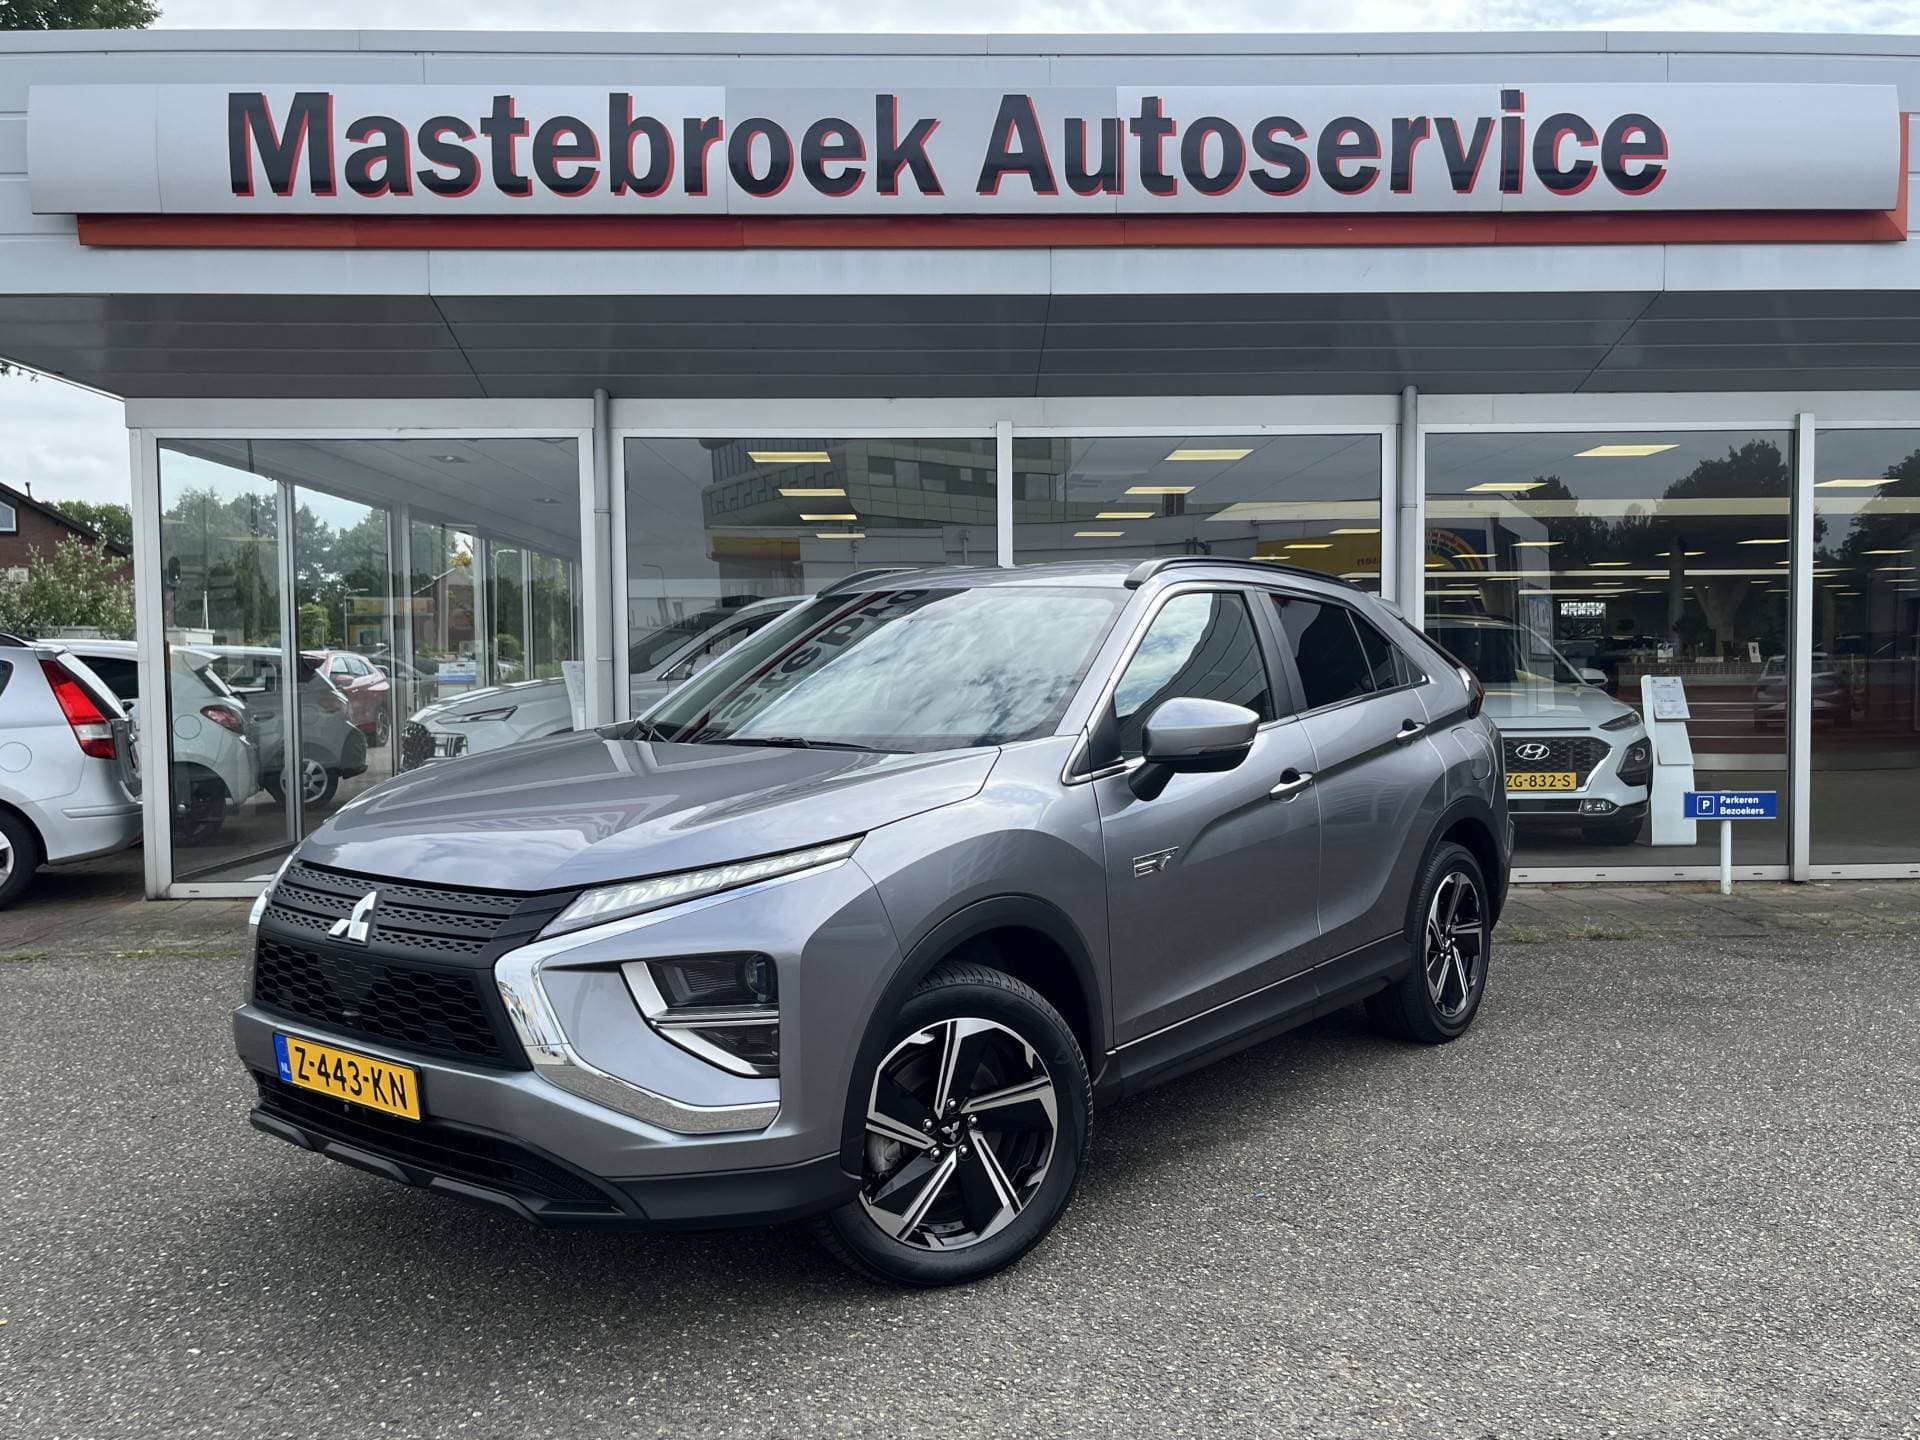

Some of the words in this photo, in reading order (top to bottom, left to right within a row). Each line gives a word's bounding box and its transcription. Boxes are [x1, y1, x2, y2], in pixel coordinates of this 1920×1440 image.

[228, 91, 944, 198] Mastebroek
[975, 88, 1670, 196] Autoservice
[1506, 774, 1571, 788] ZG-832-S
[1702, 800, 1711, 810] P
[1719, 795, 1759, 805] Parkeren
[1719, 806, 1765, 816] Bezoekers
[294, 1045, 408, 1110] Z-443-KN
